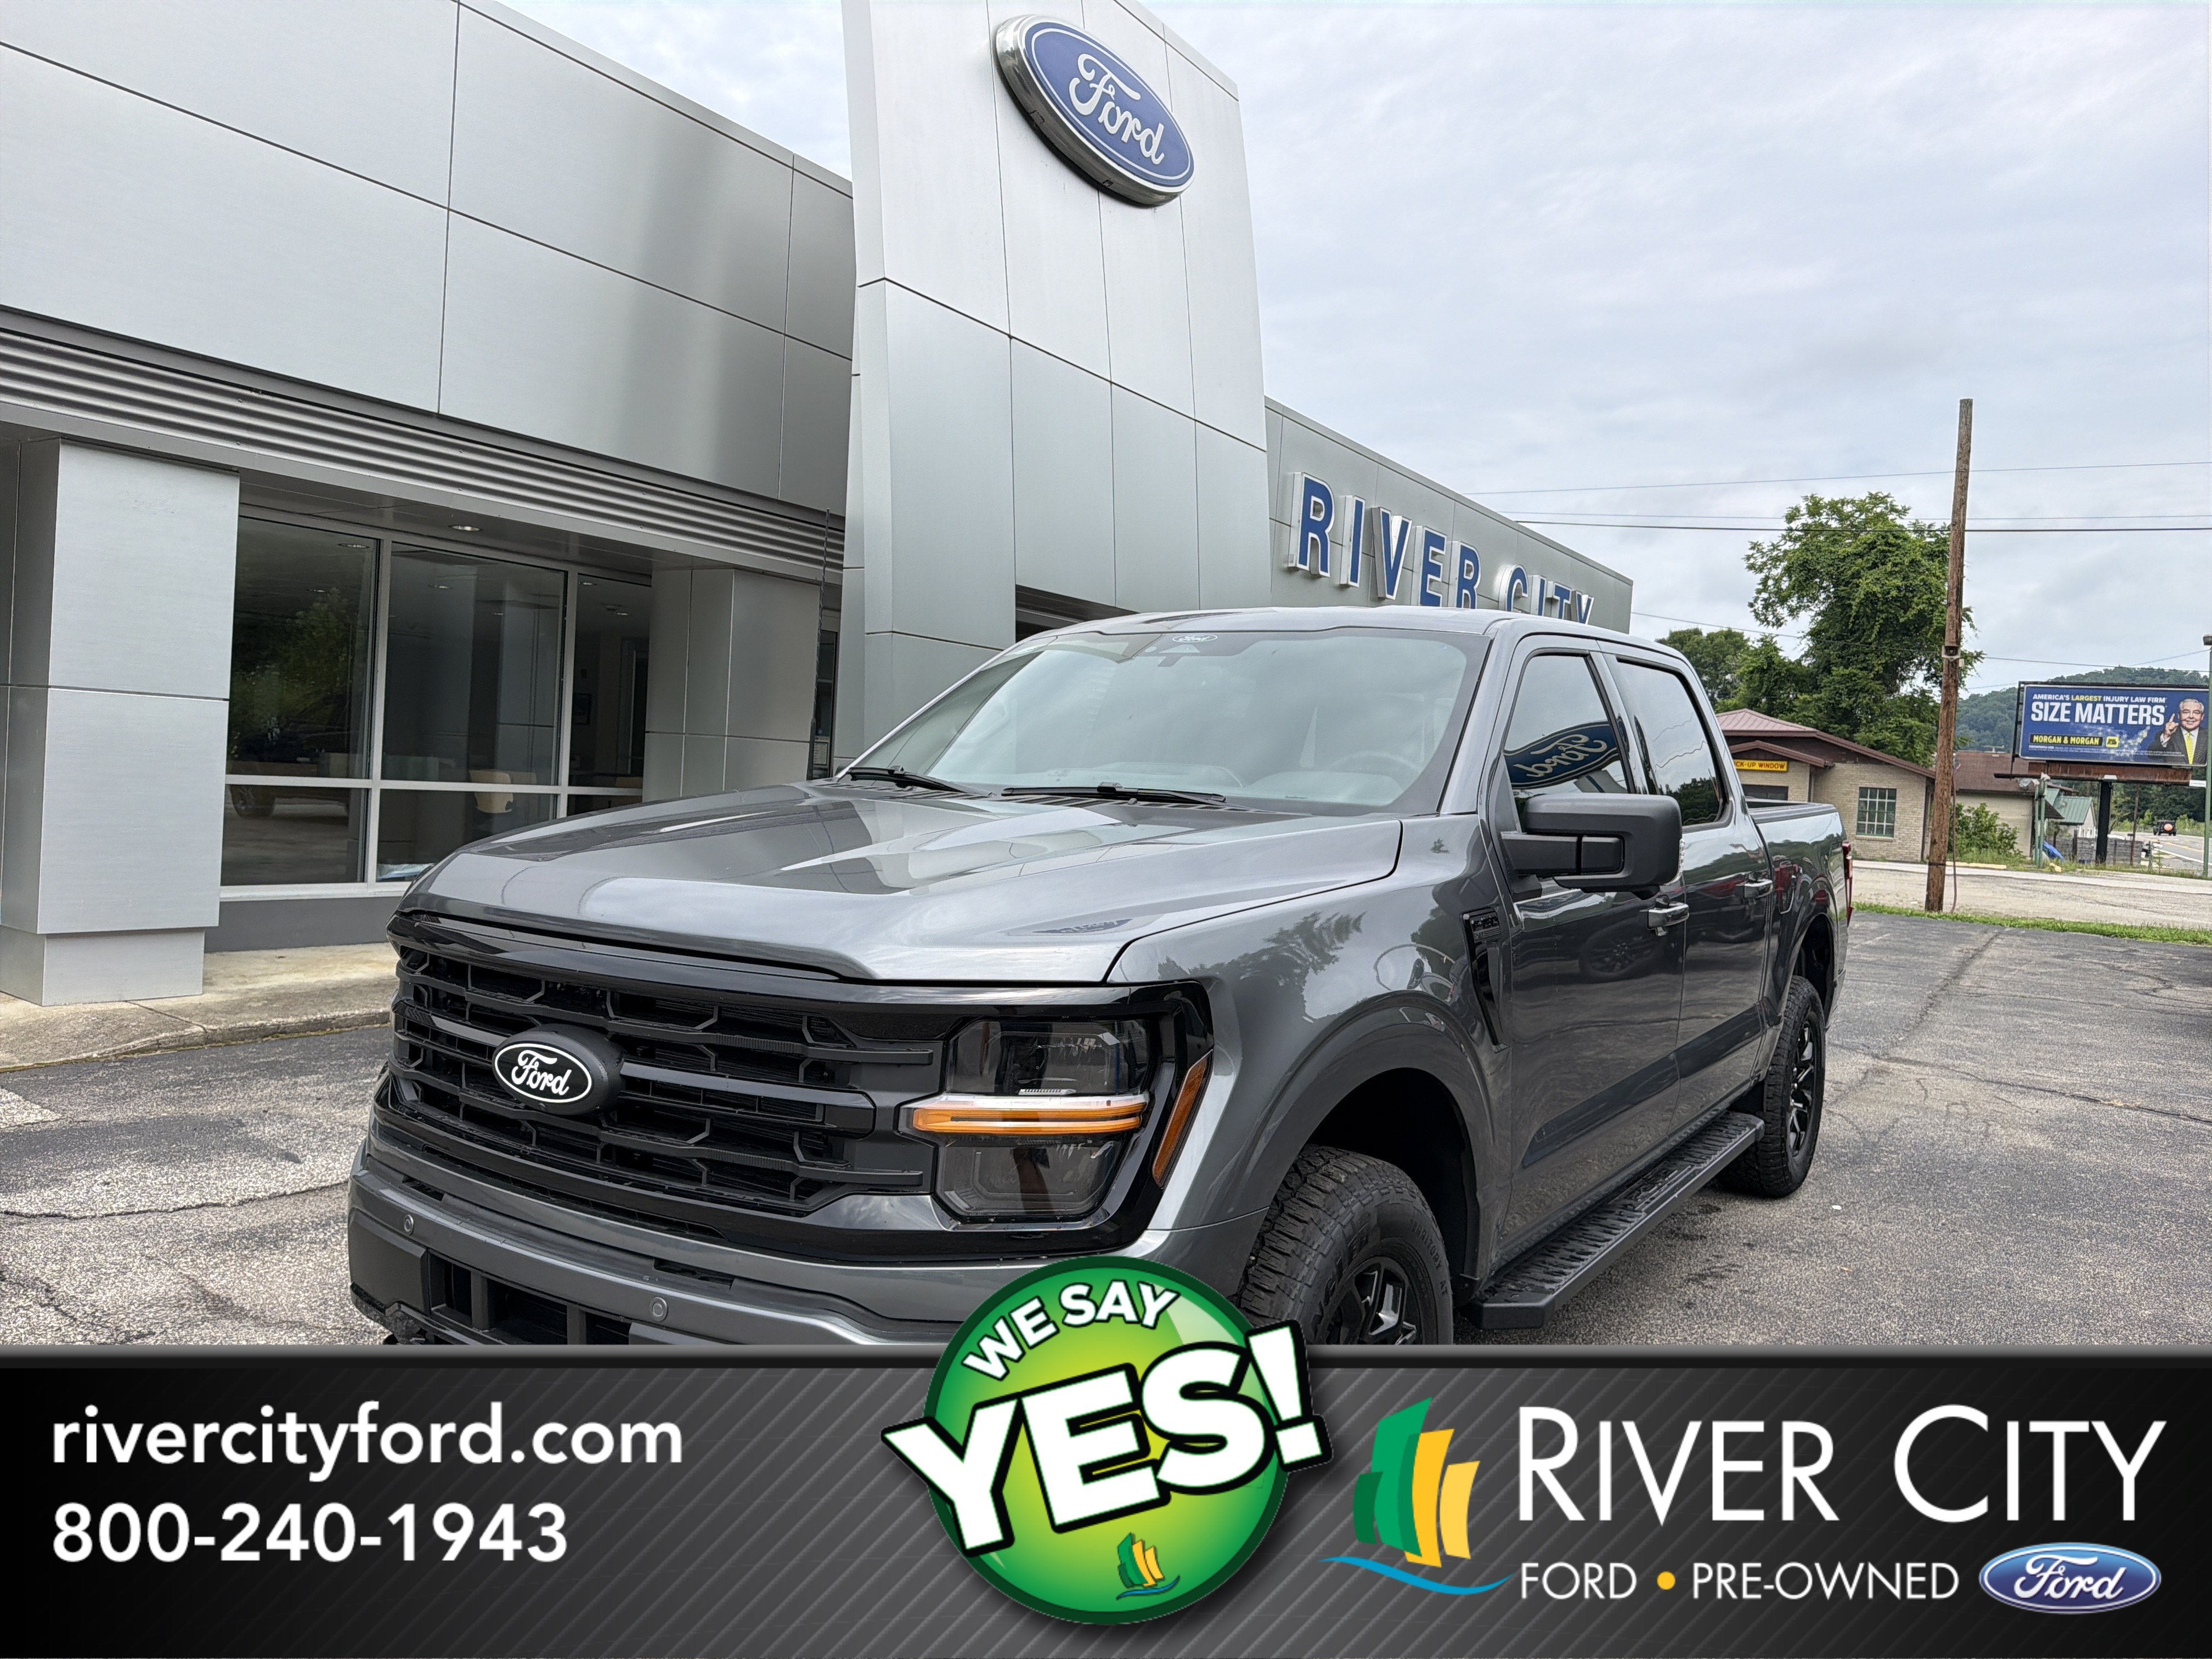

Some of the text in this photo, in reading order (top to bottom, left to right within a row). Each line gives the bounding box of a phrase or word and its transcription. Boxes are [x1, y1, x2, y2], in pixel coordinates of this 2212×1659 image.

[1069, 54, 1165, 165] Ford
[1289, 472, 1595, 624] RIVER CITY
[2031, 702, 2165, 726] SIZE MATTERS
[2033, 735, 2062, 743] MORGAN
[2070, 737, 2100, 745] MORGAN
[511, 1049, 572, 1096] Ford
